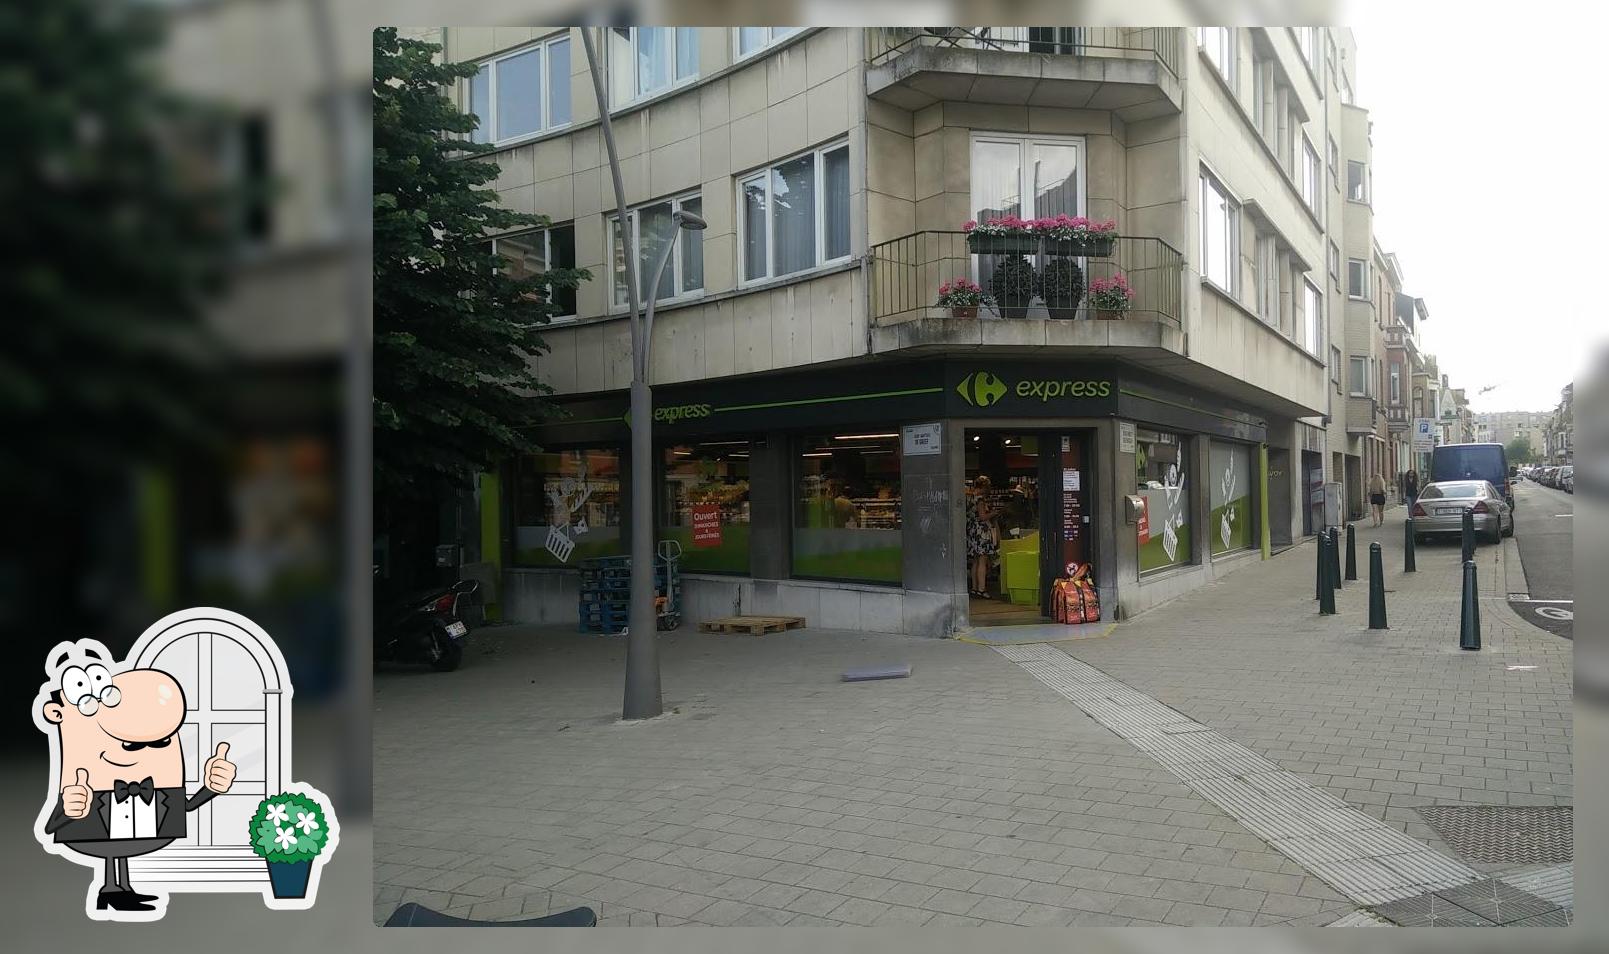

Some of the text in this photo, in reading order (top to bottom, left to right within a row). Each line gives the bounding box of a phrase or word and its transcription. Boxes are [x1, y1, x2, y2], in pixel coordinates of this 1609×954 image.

[1016, 380, 1111, 402] express
[655, 404, 710, 424] express
[693, 511, 718, 520] Ouvert
